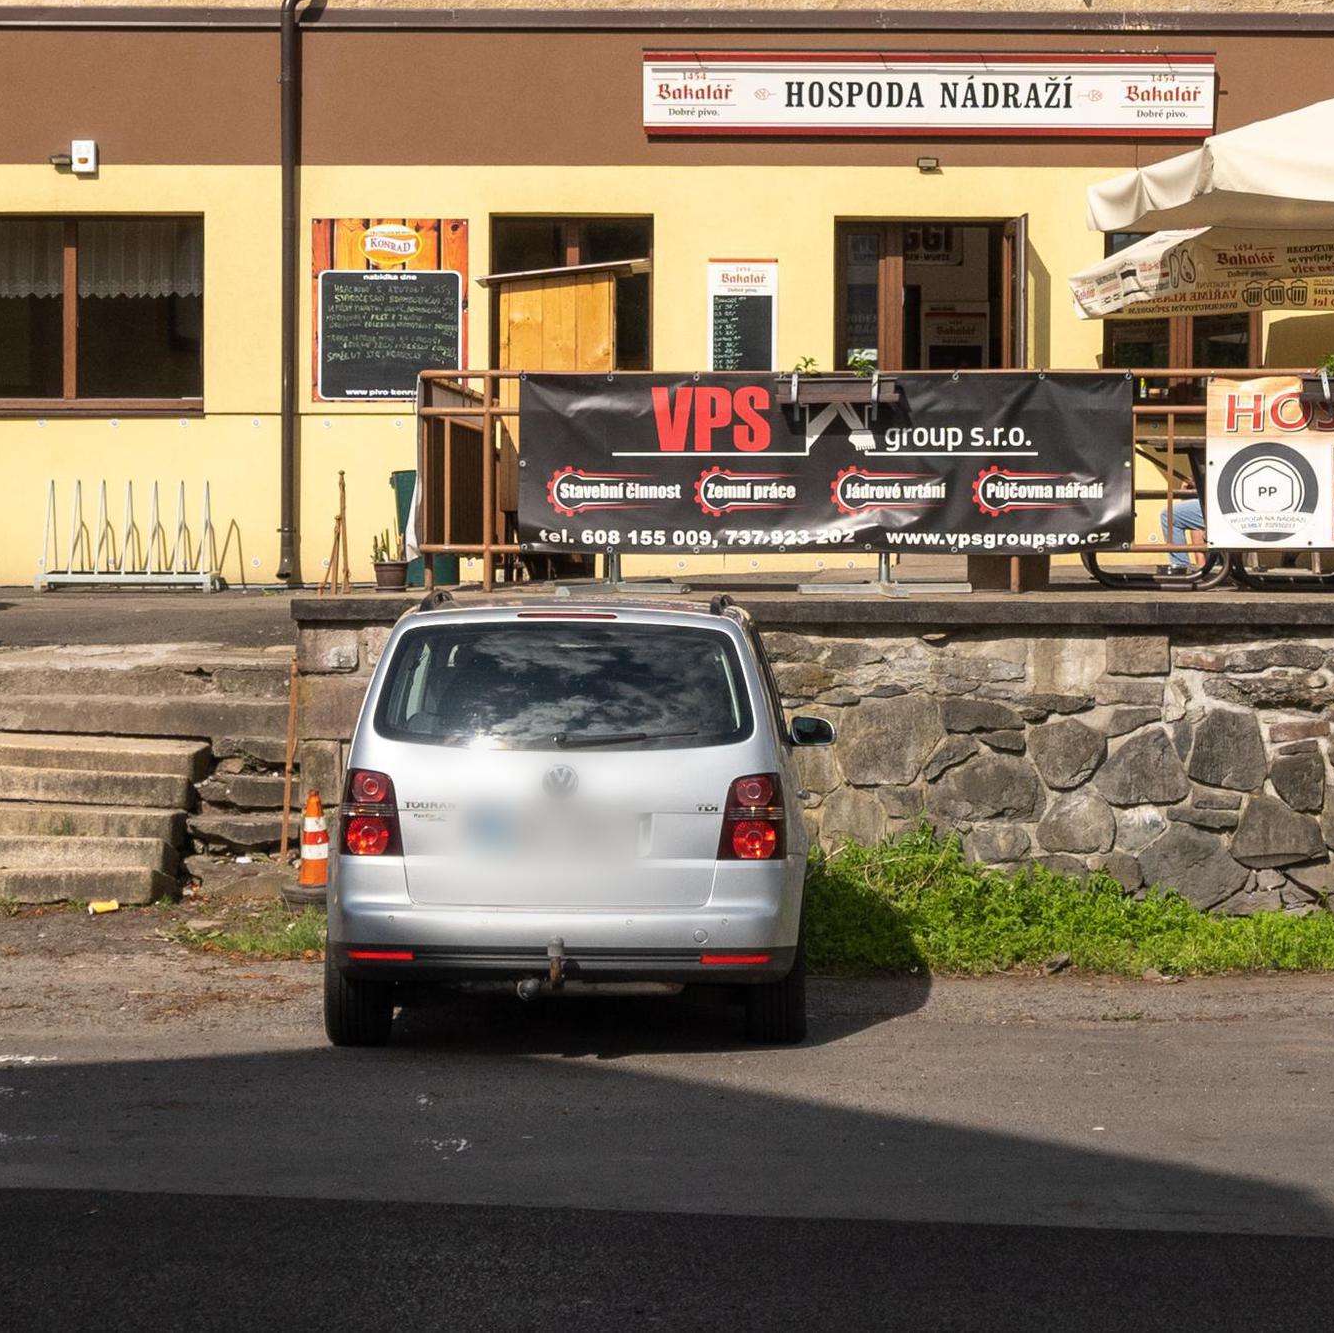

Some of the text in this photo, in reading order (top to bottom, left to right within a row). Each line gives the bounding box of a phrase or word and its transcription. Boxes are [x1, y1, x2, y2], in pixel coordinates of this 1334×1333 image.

[682, 72, 707, 81] 1454
[1151, 74, 1176, 82] 1454
[657, 83, 733, 100] Bakalář
[785, 75, 1072, 108] HOSPODA NÁDRAŽÍ
[1126, 85, 1201, 102] Bakalář
[668, 107, 720, 118] Dobré pivo.
[1137, 110, 1188, 120] Dobré pivo.
[370, 237, 411, 253] KONRAD
[1217, 252, 1276, 266] Bakalář
[721, 273, 767, 283] Bakalář
[651, 386, 771, 452] VPS
[885, 427, 1031, 451] group s.r.o.
[559, 482, 681, 499] Stavební činnost
[707, 483, 796, 501] Zemní práce
[845, 482, 946, 499] Jádrové vrtání
[986, 481, 1103, 500] Půjčovna nářadí
[1258, 486, 1277, 497] PP
[539, 530, 574, 544] tel.
[581, 530, 621, 545] 608
[627, 530, 666, 545] 155
[673, 530, 718, 548] 009,
[816, 529, 855, 544] 202
[885, 530, 1110, 549] www.vpsgroupsro.cz
